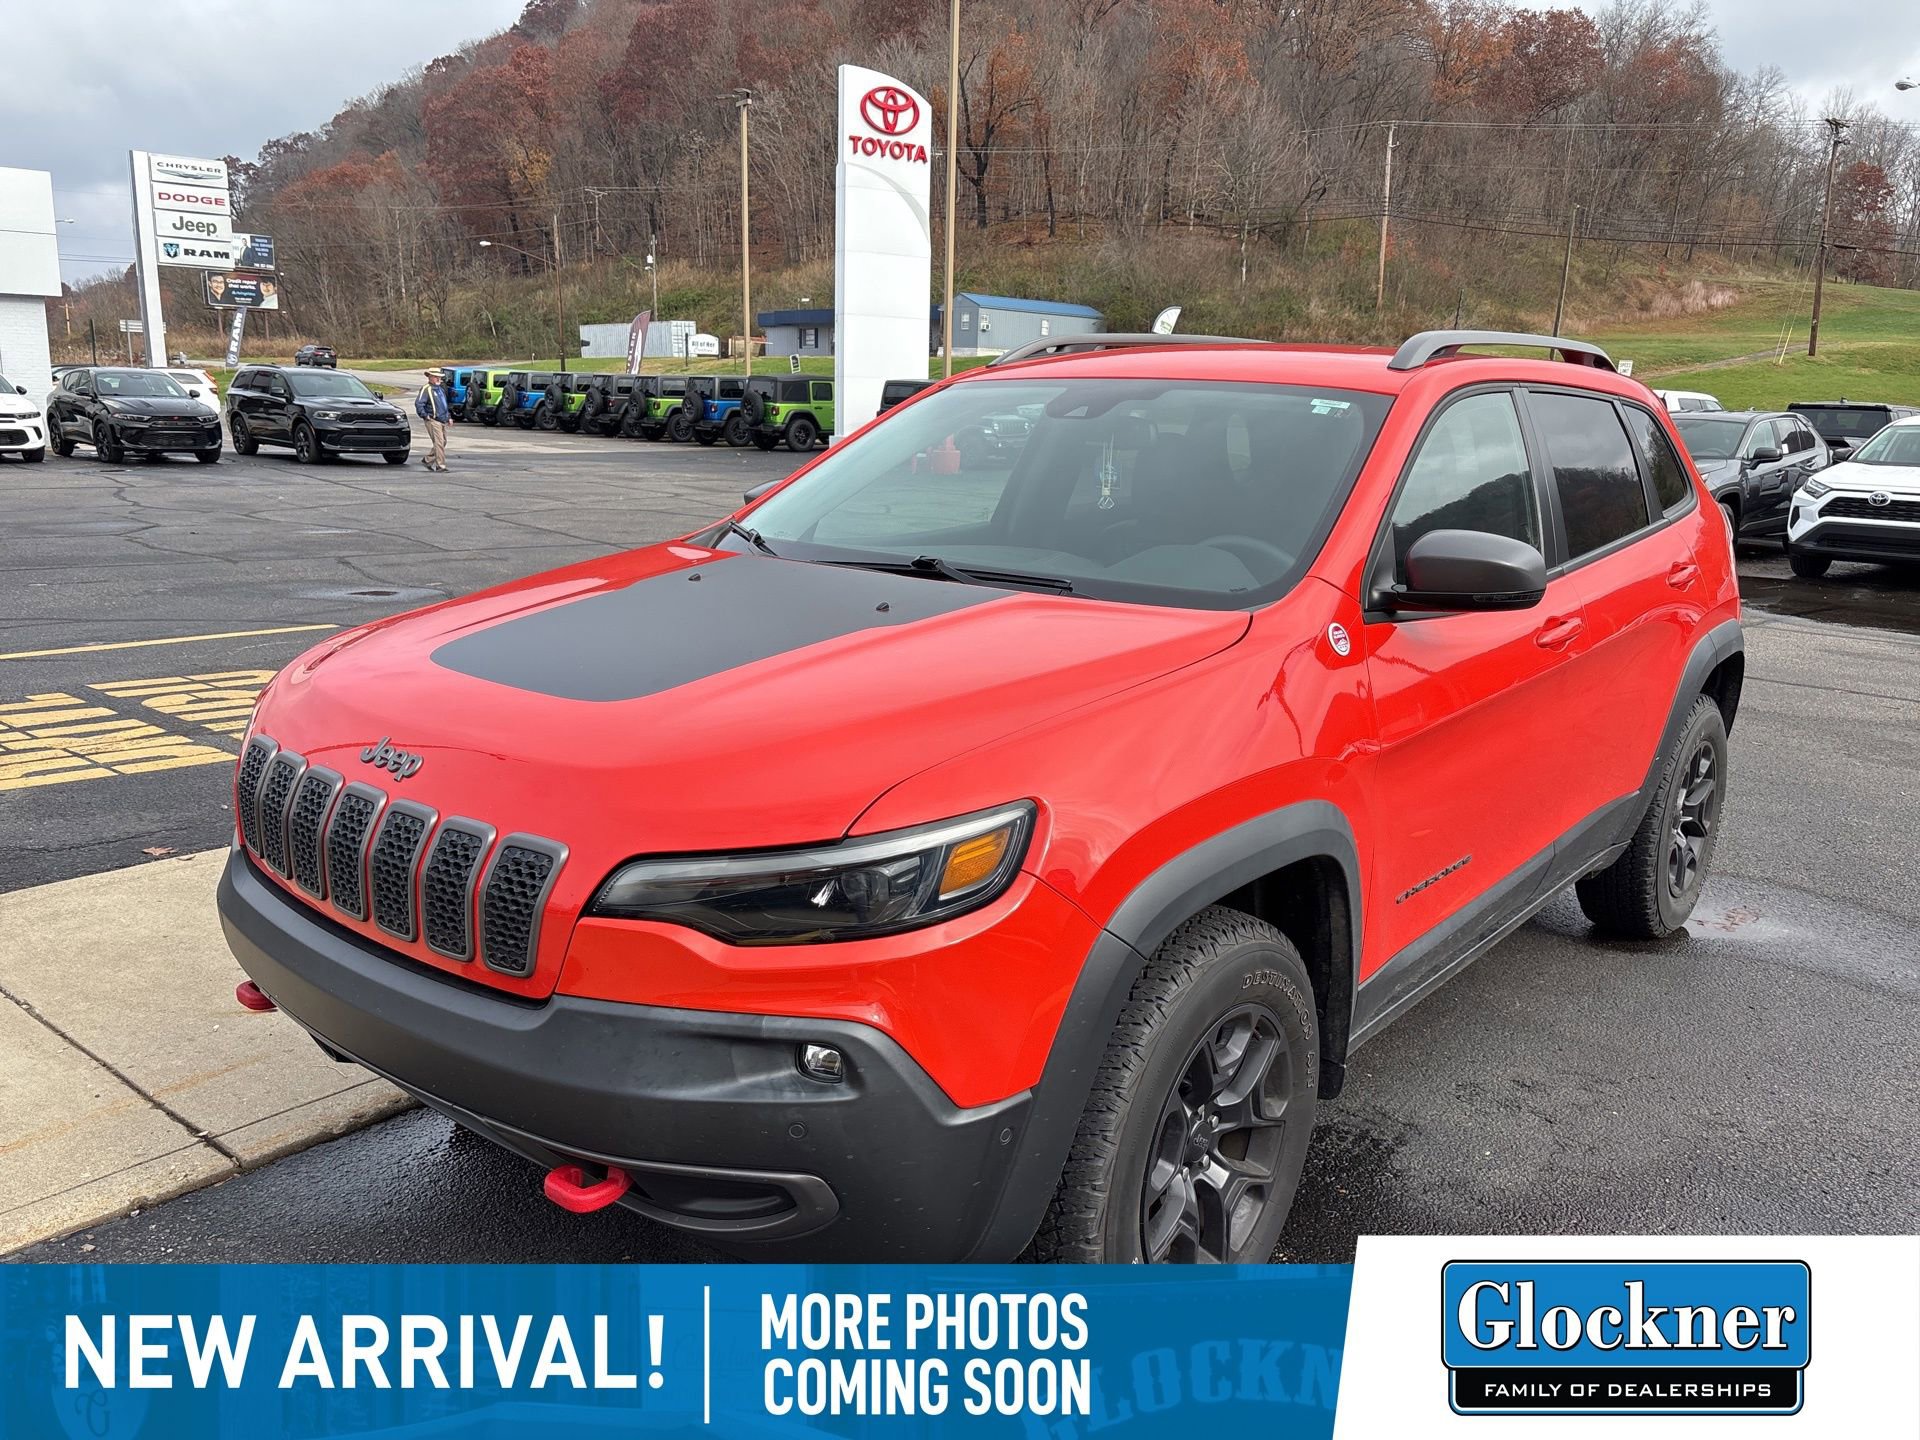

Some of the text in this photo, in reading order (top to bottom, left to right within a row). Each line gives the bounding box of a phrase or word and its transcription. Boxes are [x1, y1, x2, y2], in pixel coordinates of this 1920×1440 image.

[849, 135, 928, 164] TOYOTA
[157, 161, 222, 174] CHRYSLER
[158, 192, 226, 207] DODGE
[172, 215, 218, 237] Jeep
[183, 248, 231, 260] RAM
[229, 312, 243, 353] RAM
[360, 735, 424, 783] Jeep
[1242, 970, 1314, 1041] DESTINATION
